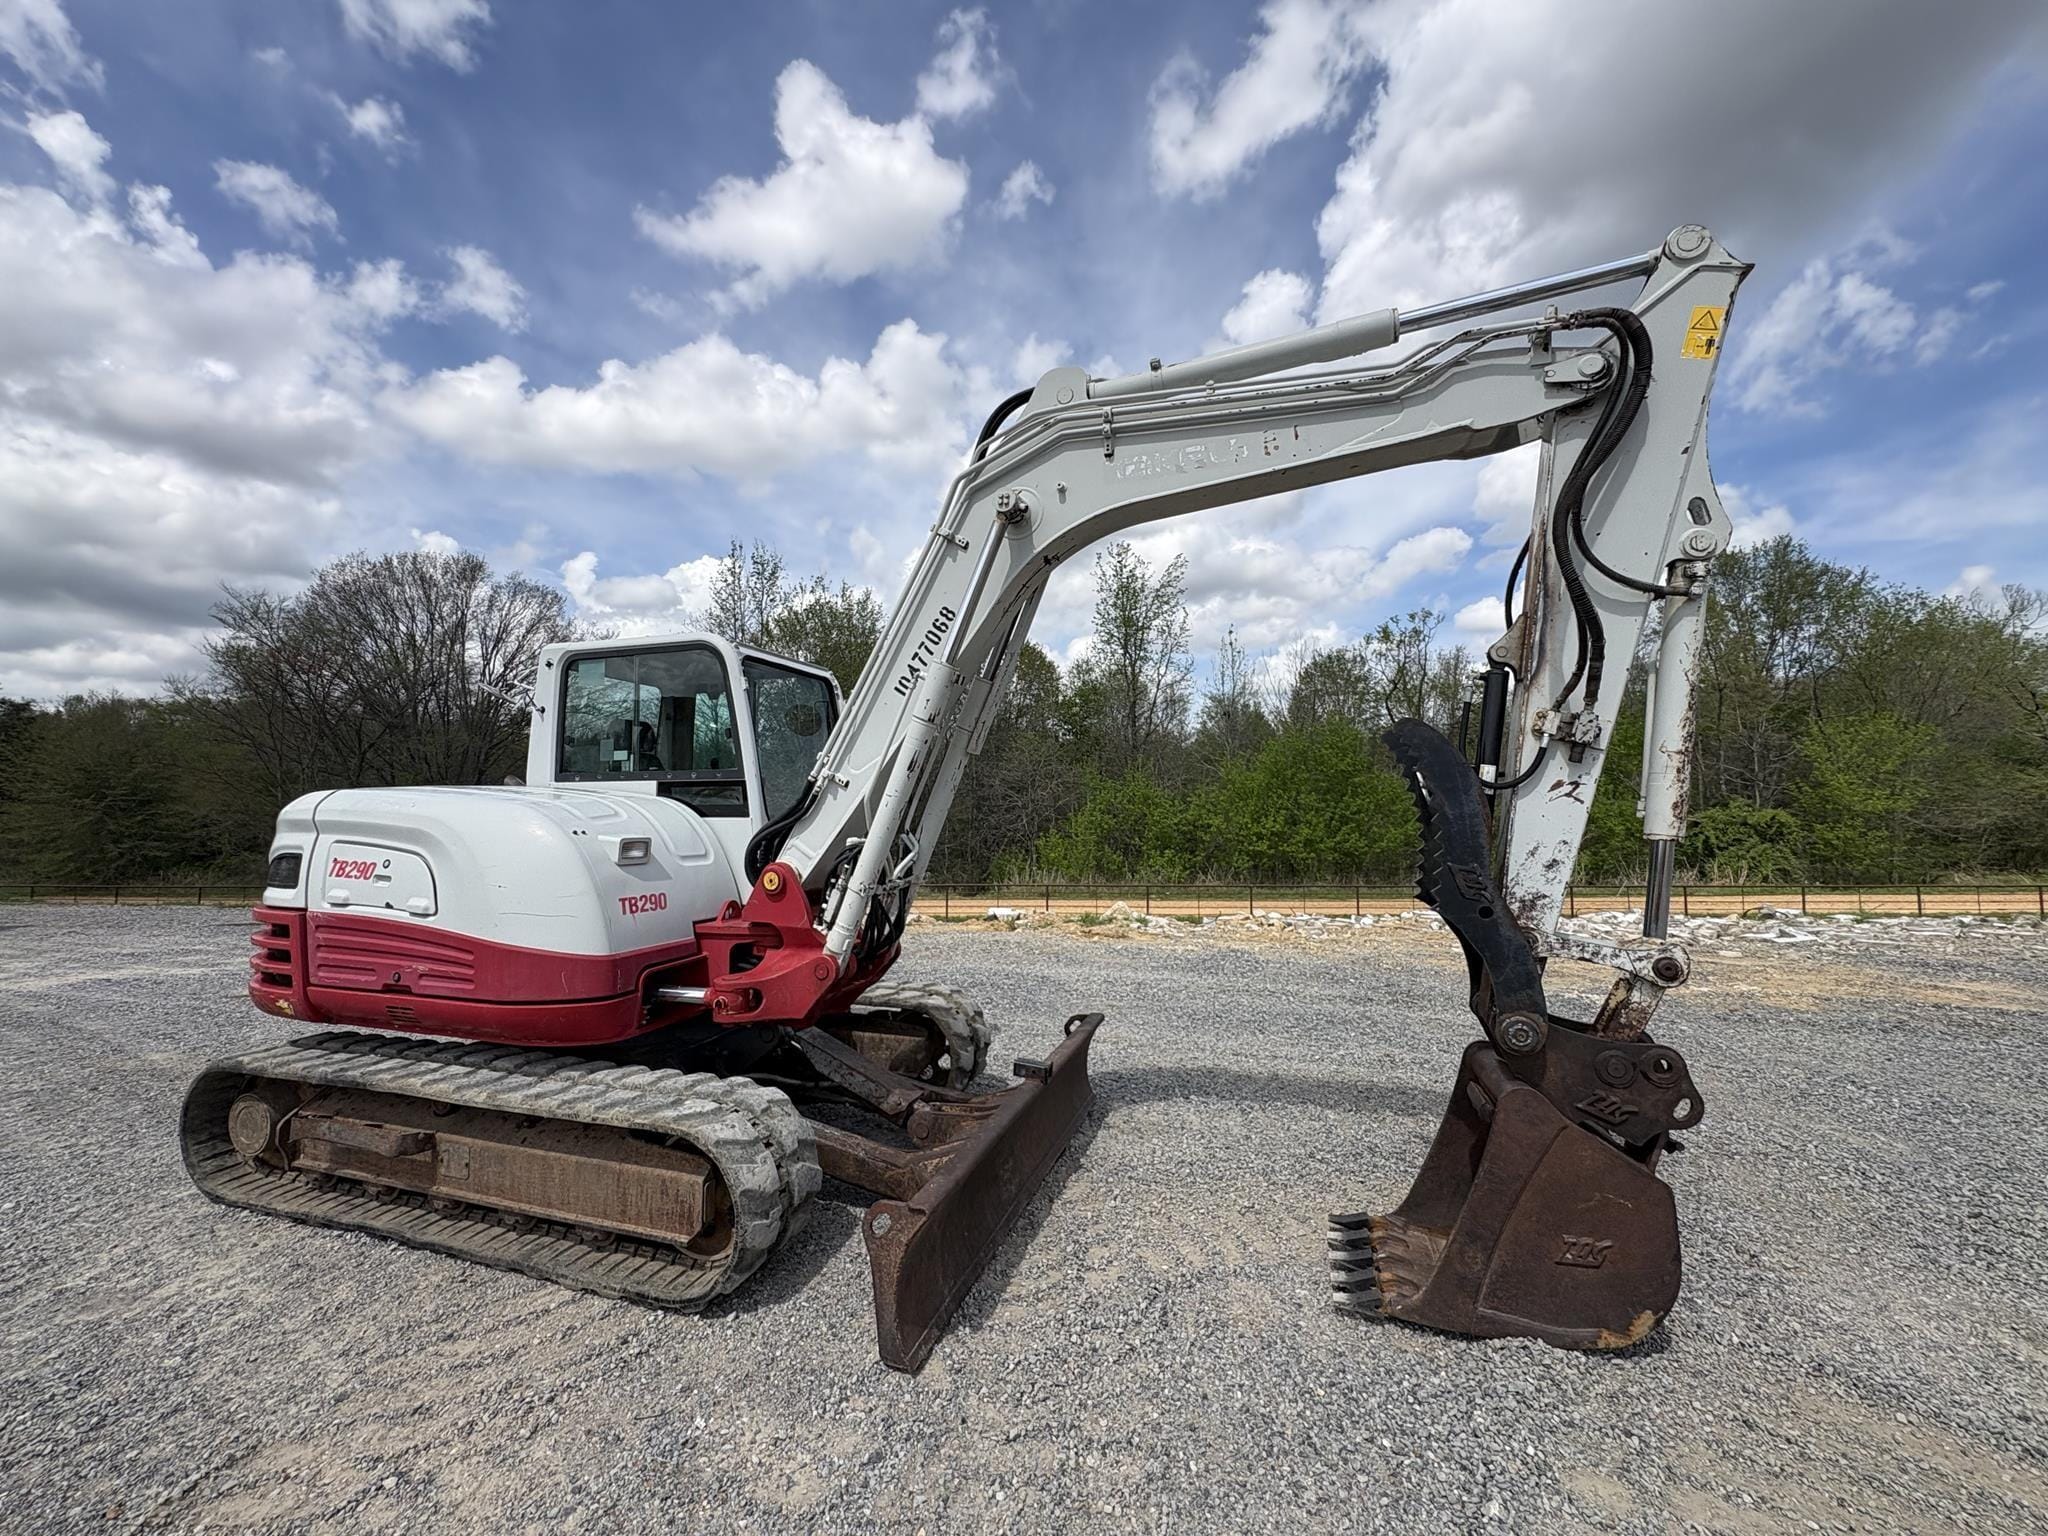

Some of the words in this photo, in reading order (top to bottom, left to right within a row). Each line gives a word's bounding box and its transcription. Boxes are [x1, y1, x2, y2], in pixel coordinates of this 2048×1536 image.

[894, 606, 956, 697] 10477068
[328, 858, 377, 880] TB290
[618, 892, 667, 915] TB290
